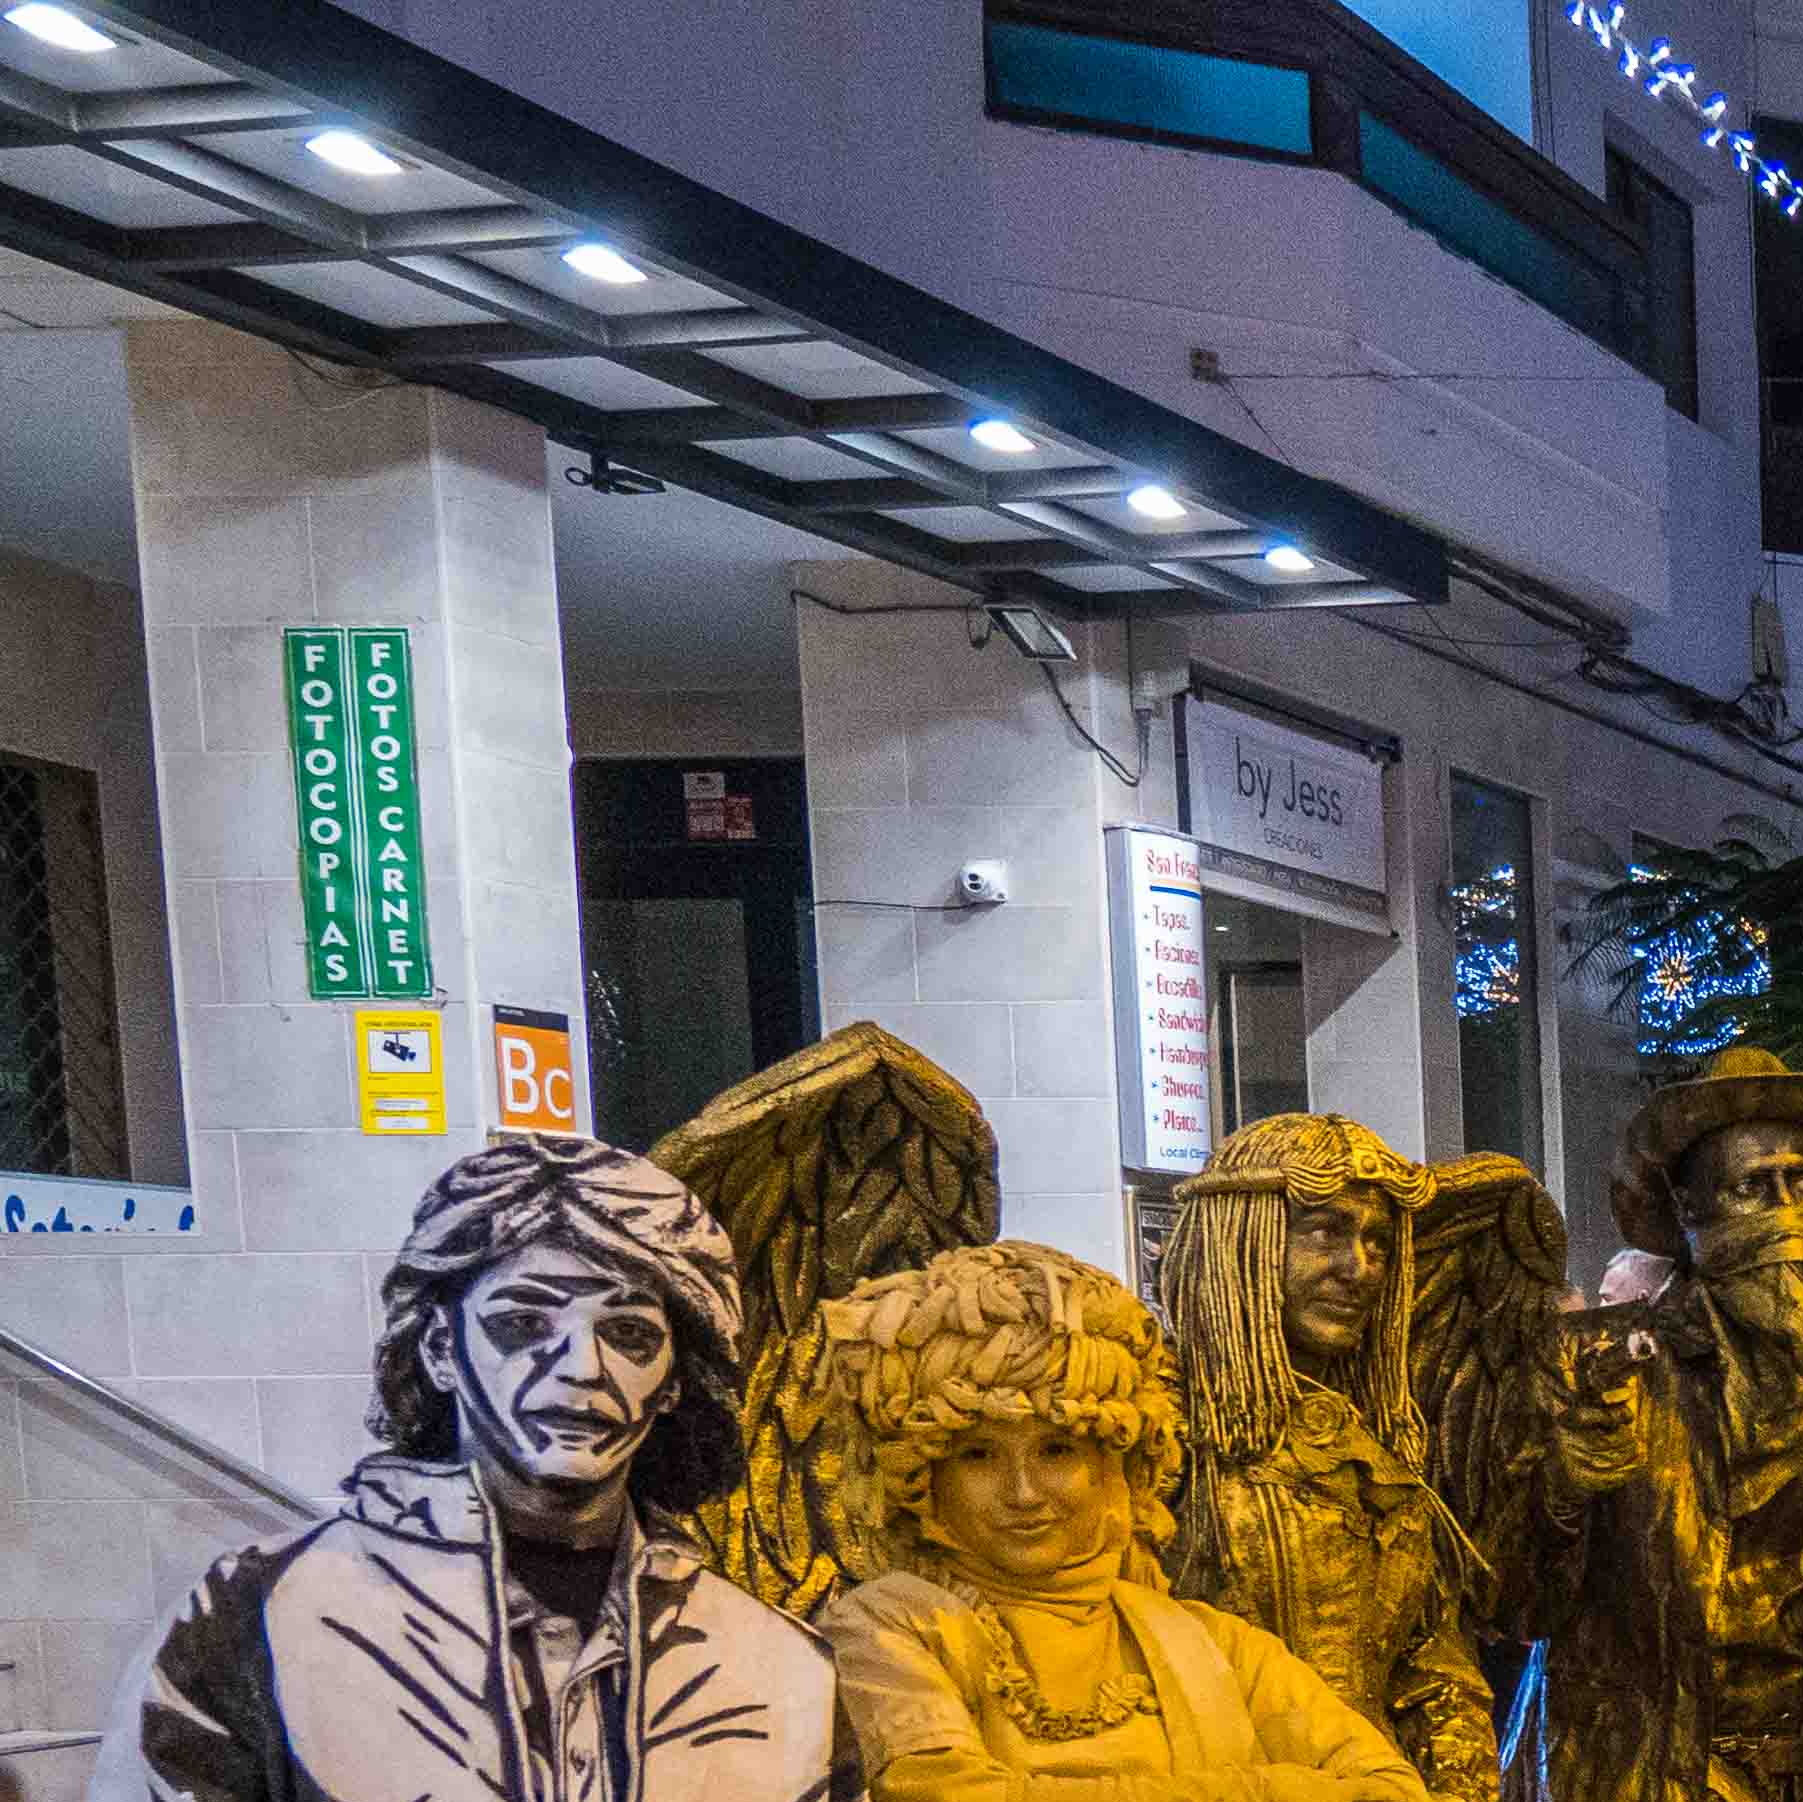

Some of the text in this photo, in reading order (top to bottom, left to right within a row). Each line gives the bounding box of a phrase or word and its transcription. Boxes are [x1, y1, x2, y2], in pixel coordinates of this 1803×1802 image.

[366, 642, 401, 792] FOTOS
[1235, 735, 1343, 826] by Jess
[301, 645, 350, 983] FOTOCOPIAS
[377, 806, 414, 985] CARNET
[501, 1036, 572, 1119] Bc
